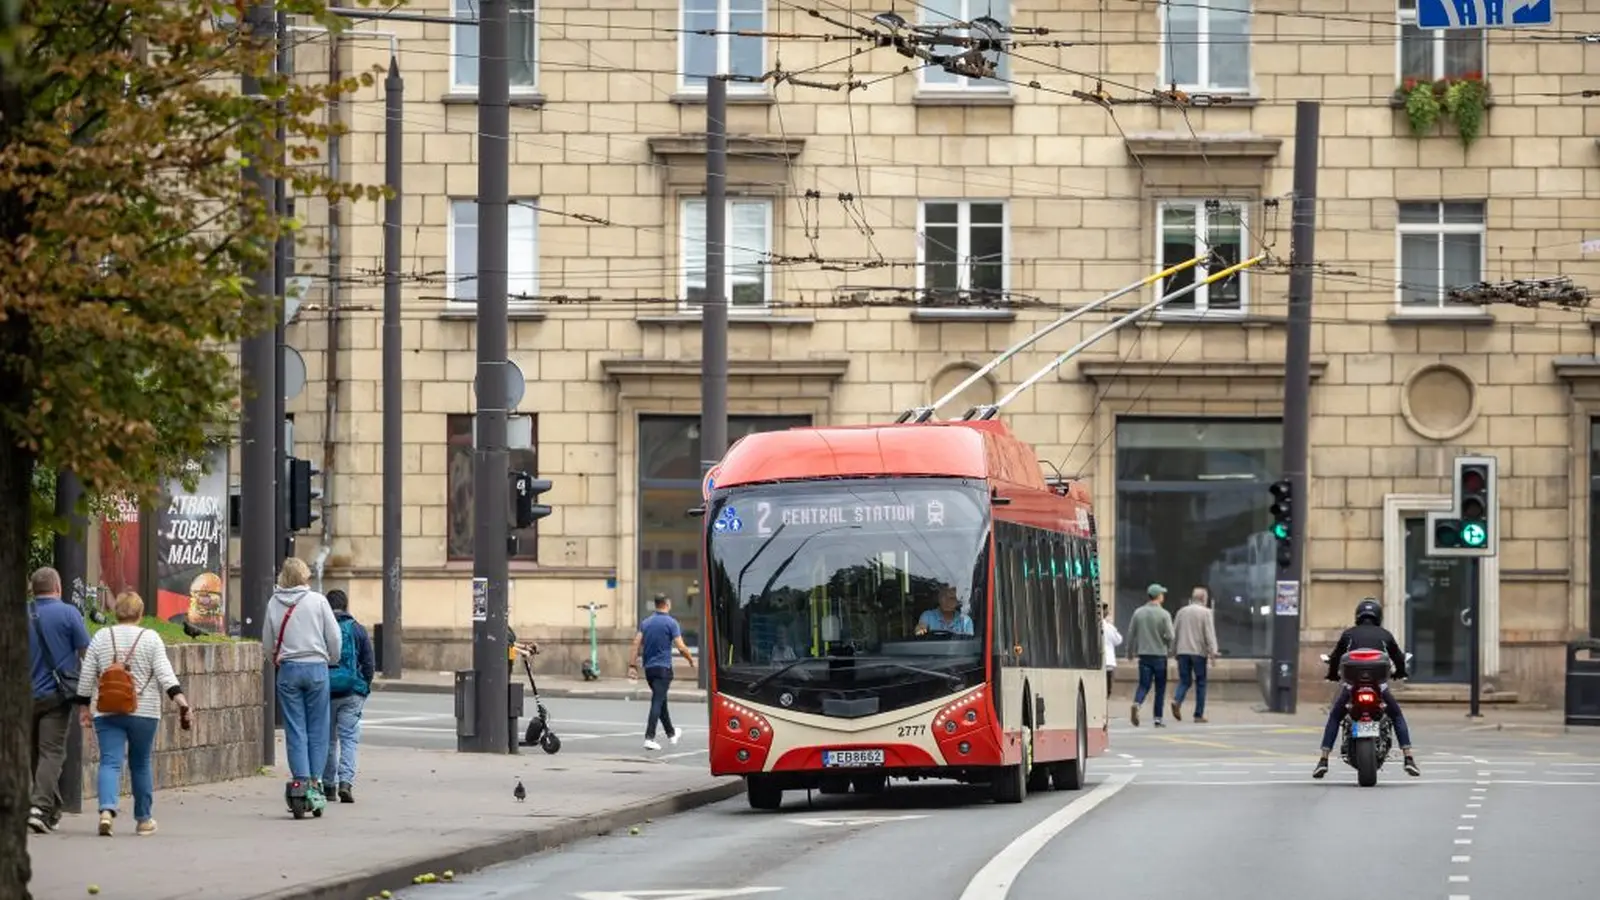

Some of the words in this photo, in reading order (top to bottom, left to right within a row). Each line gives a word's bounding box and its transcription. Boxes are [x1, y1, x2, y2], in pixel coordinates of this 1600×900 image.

[757, 502, 772, 534] 2
[782, 508, 847, 525] CENTRAL
[855, 505, 915, 523] STATION
[170, 519, 219, 544] TOBULĄ
[167, 541, 209, 568] MAČĄ
[898, 725, 926, 738] 2777
[837, 751, 881, 763] EB8662
